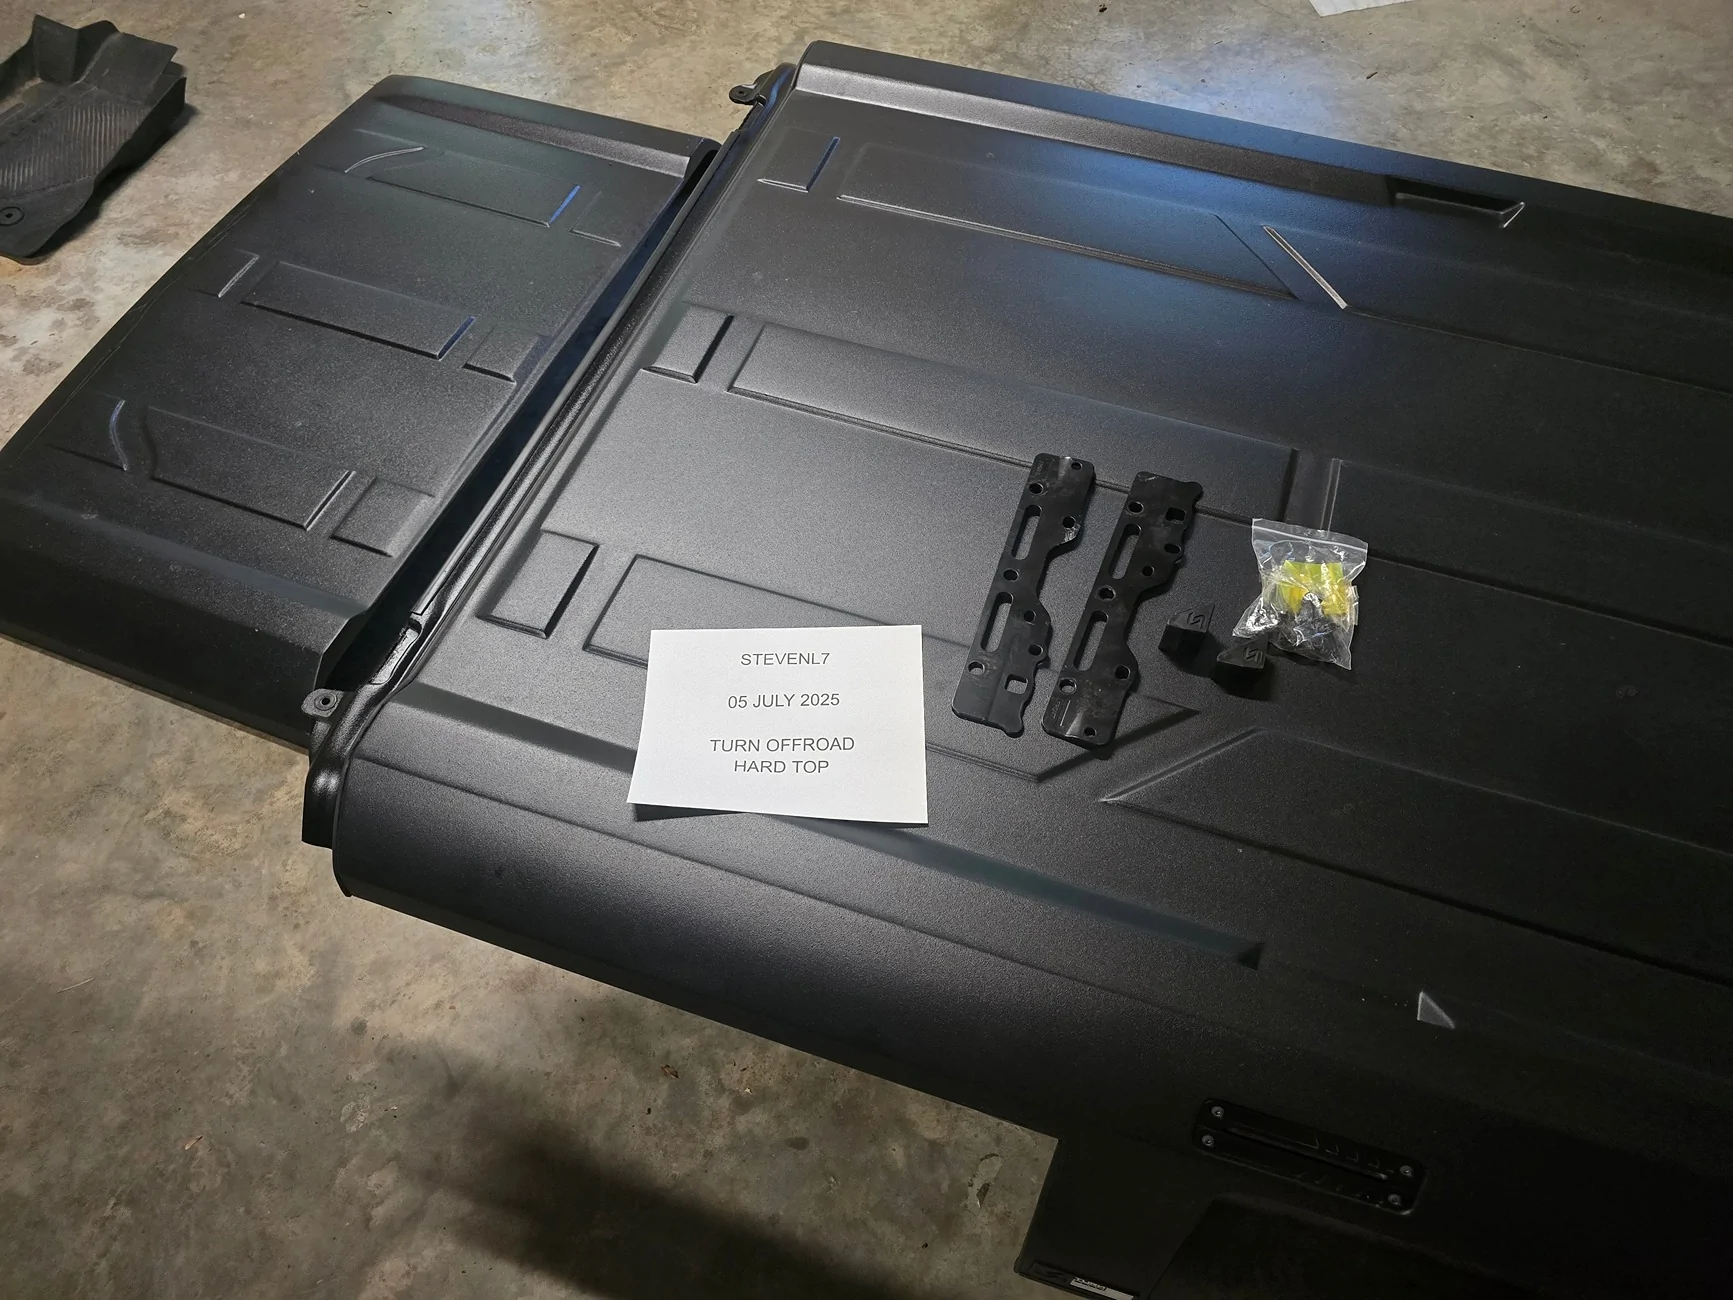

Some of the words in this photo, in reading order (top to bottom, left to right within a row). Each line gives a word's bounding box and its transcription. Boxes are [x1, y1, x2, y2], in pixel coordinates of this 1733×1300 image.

[740, 652, 830, 666] STEVENL7
[728, 695, 748, 709] 05
[752, 693, 796, 708] JULY
[800, 693, 840, 707] 2025
[709, 739, 760, 752] TURN
[766, 736, 855, 752] OFFROAD
[734, 760, 786, 774] HARD
[791, 760, 829, 774] TOP
